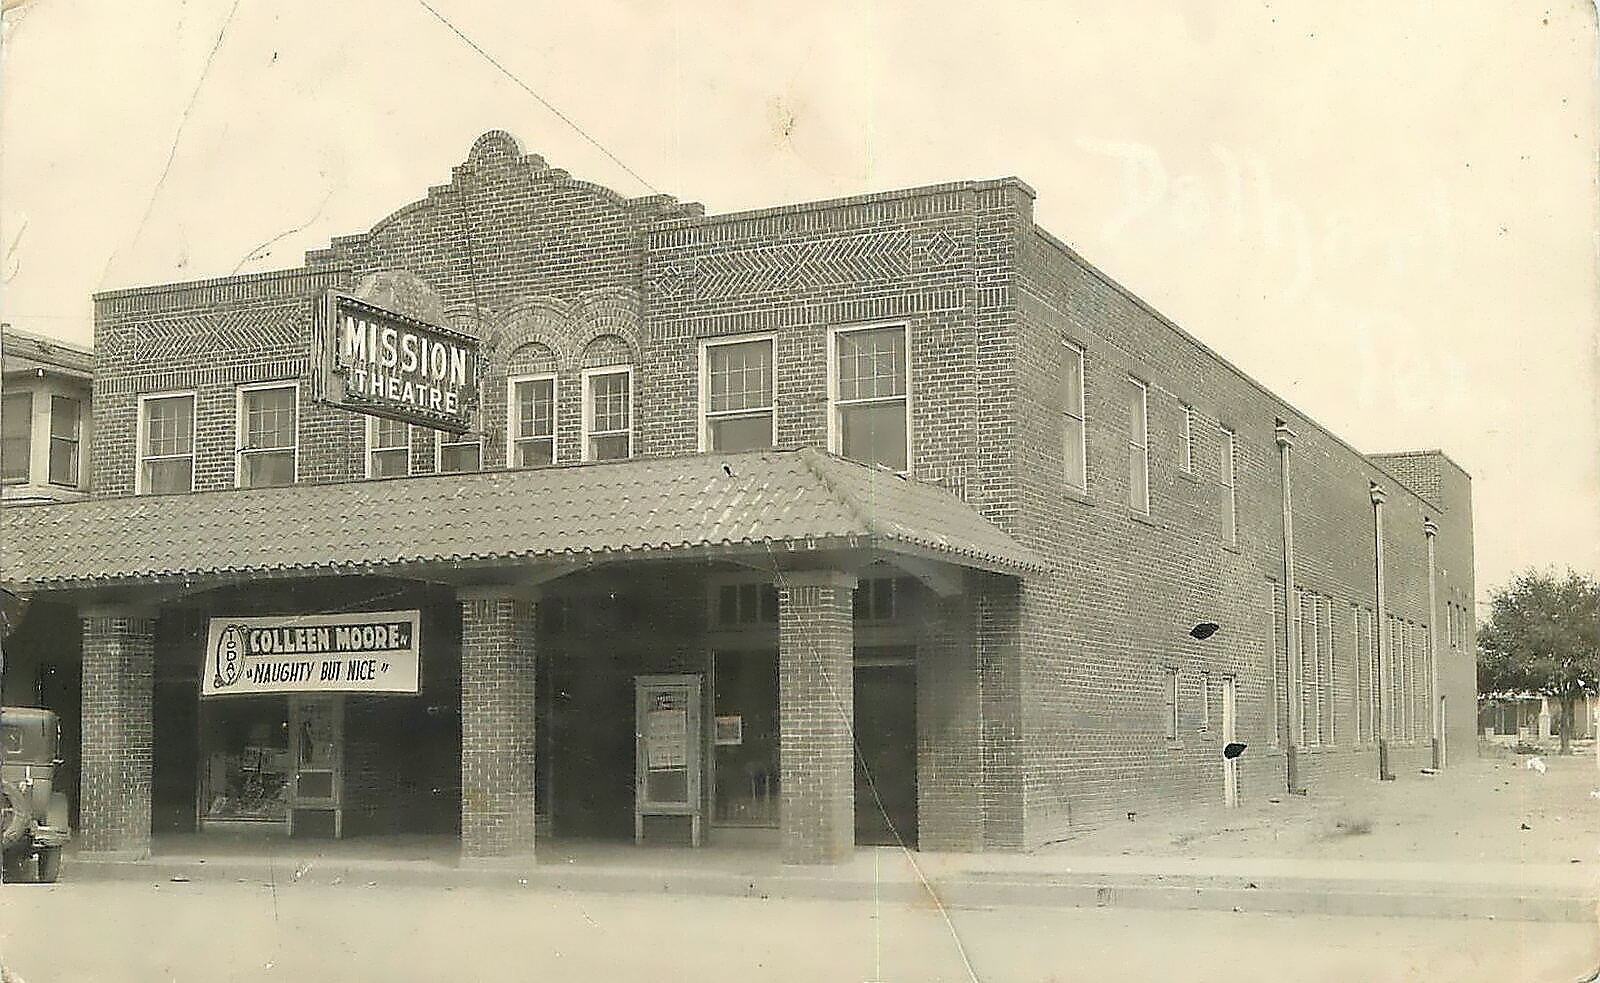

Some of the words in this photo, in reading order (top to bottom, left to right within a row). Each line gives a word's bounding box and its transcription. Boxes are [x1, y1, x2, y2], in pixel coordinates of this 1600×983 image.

[339, 316, 466, 386] MISSION
[354, 368, 457, 414] THEATRE
[226, 628, 237, 685] TODAY
[250, 627, 329, 653] COLLEEN
[335, 624, 399, 650] MOORE
[320, 661, 342, 681] BUT
